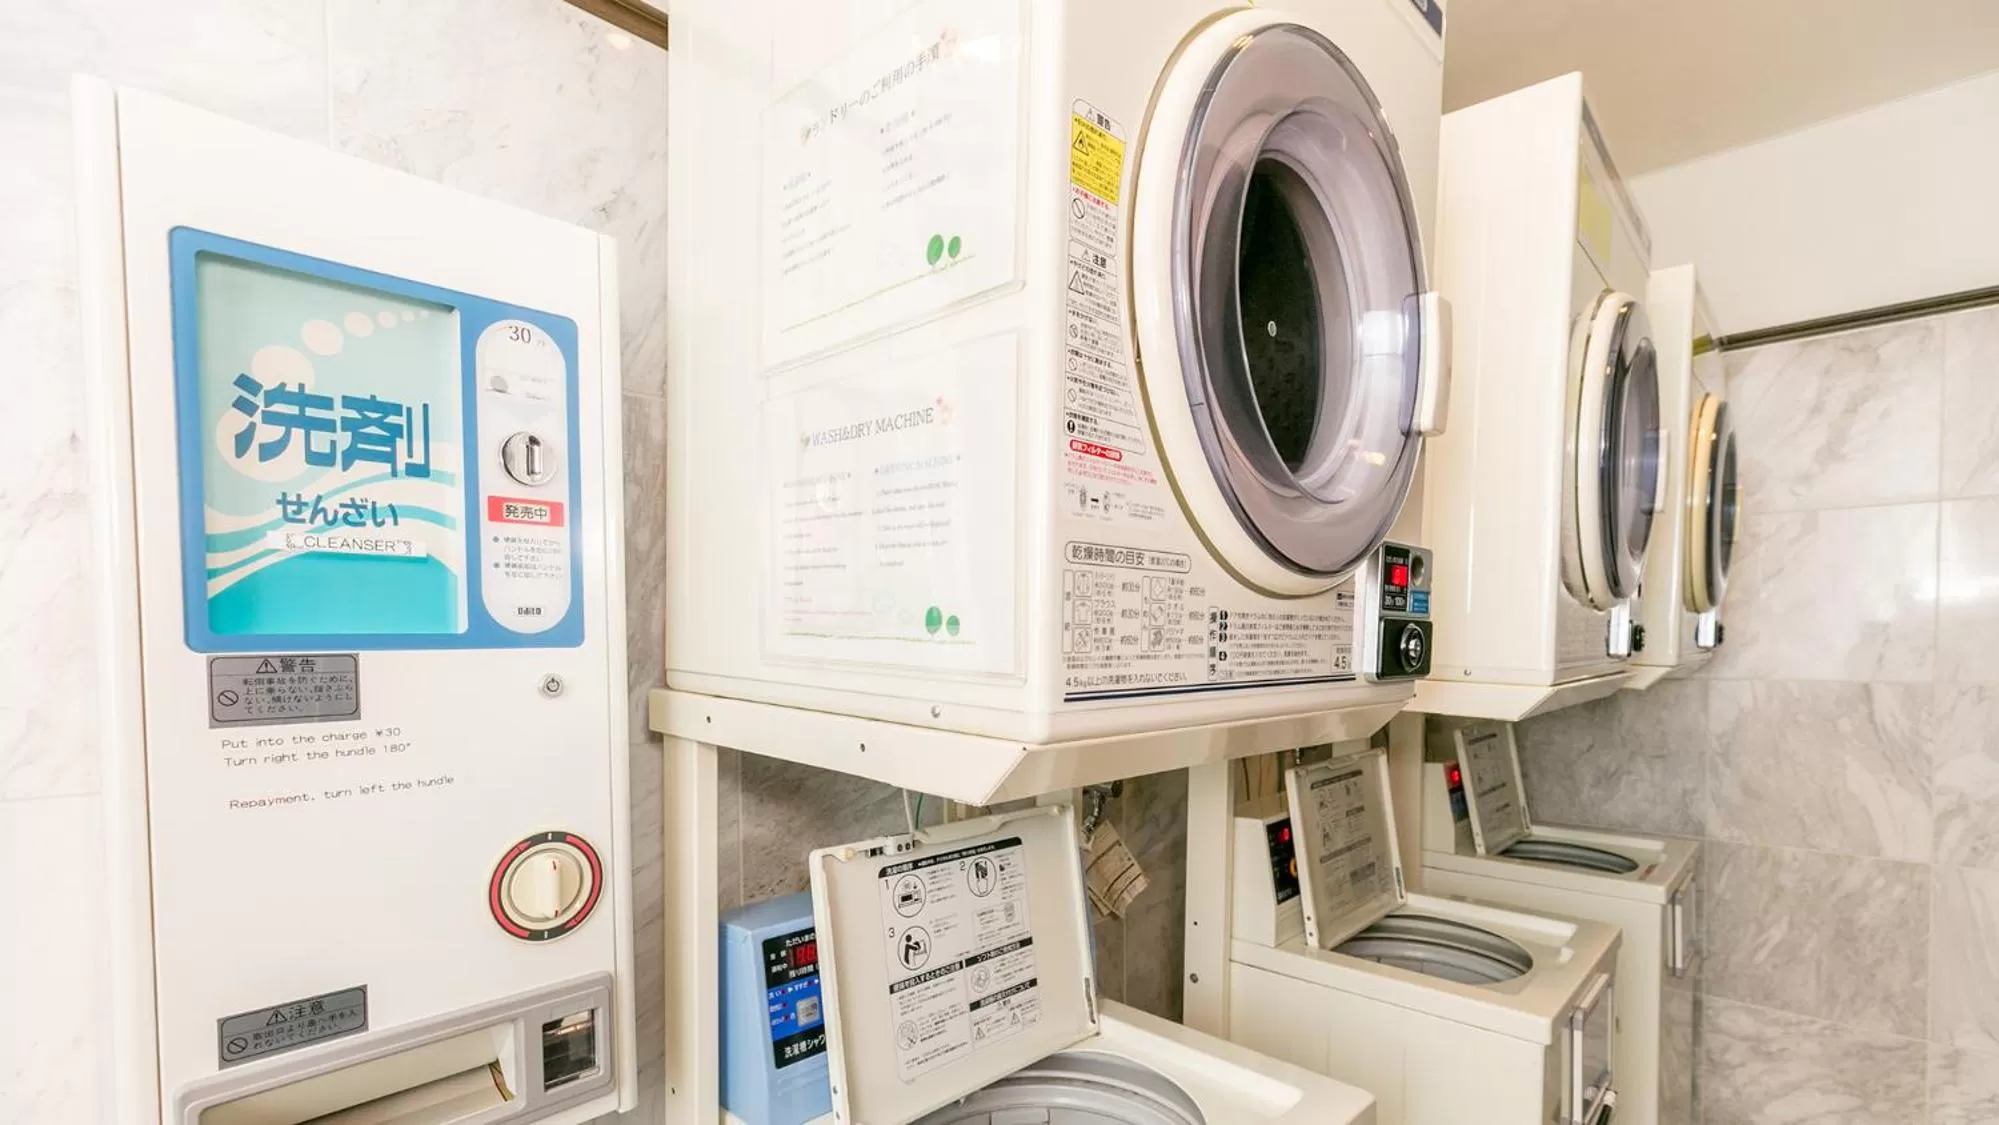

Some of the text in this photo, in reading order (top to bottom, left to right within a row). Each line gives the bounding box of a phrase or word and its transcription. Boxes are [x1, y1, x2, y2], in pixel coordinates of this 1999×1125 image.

[508, 326, 532, 344] 30
[231, 373, 431, 478] 洗剤
[812, 407, 935, 447] WASH&DRY MACHINE
[276, 491, 400, 527] せんざい
[505, 504, 548, 520] 発売中
[303, 535, 396, 553] CLEANSER
[279, 657, 317, 673] 警告
[222, 739, 249, 750] Put
[256, 737, 285, 747] into
[292, 735, 316, 744] the
[321, 730, 368, 743] charge
[224, 756, 257, 768] Turn
[264, 752, 299, 767] right
[306, 750, 329, 761] the
[335, 746, 377, 758] hundle
[324, 788, 353, 800] turn
[359, 783, 386, 796] left
[392, 780, 413, 791] the
[417, 775, 455, 788] hundle
[888, 927, 896, 939] 3
[288, 1000, 325, 1022] 注意
